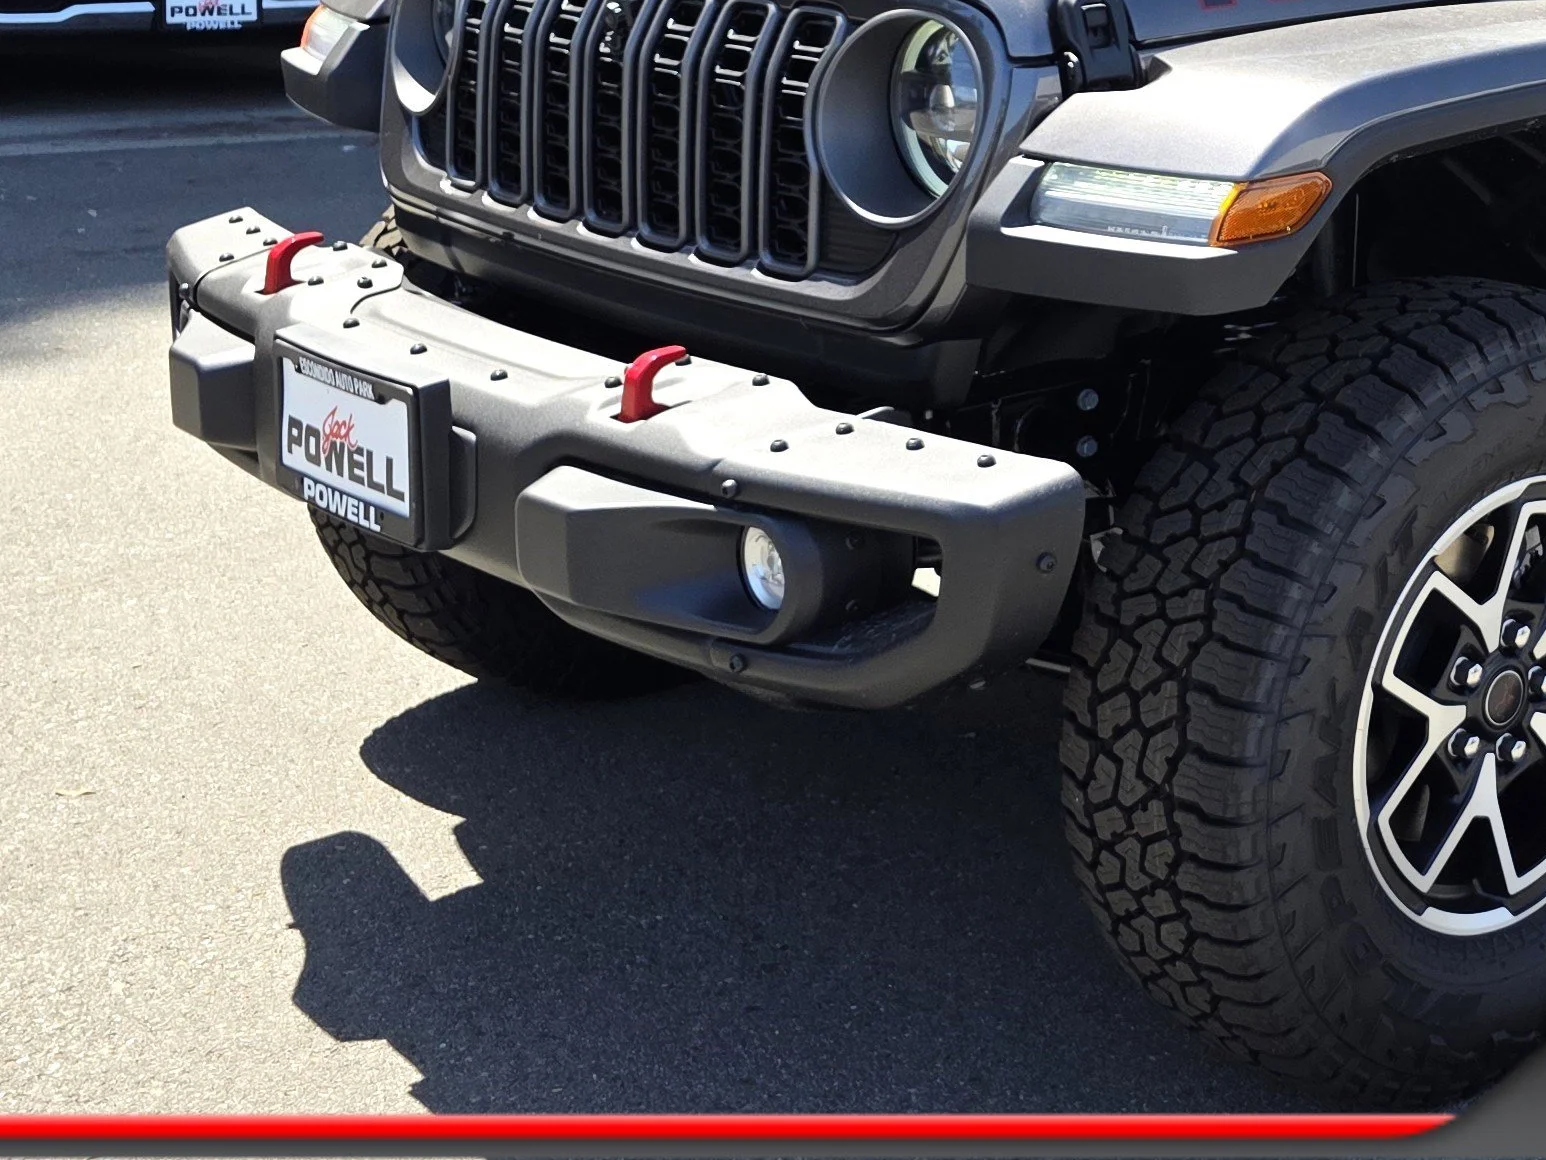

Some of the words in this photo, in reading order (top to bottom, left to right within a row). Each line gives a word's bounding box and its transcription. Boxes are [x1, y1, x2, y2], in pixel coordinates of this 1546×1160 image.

[170, 4, 252, 18] POWELL
[186, 20, 242, 31] POWELL
[299, 357, 334, 388] ESCONDIDO
[335, 370, 353, 393] AUTO
[353, 377, 376, 400] PARK
[322, 406, 357, 457] Jack
[287, 415, 405, 503] POWELL
[303, 476, 381, 532] POWELL
